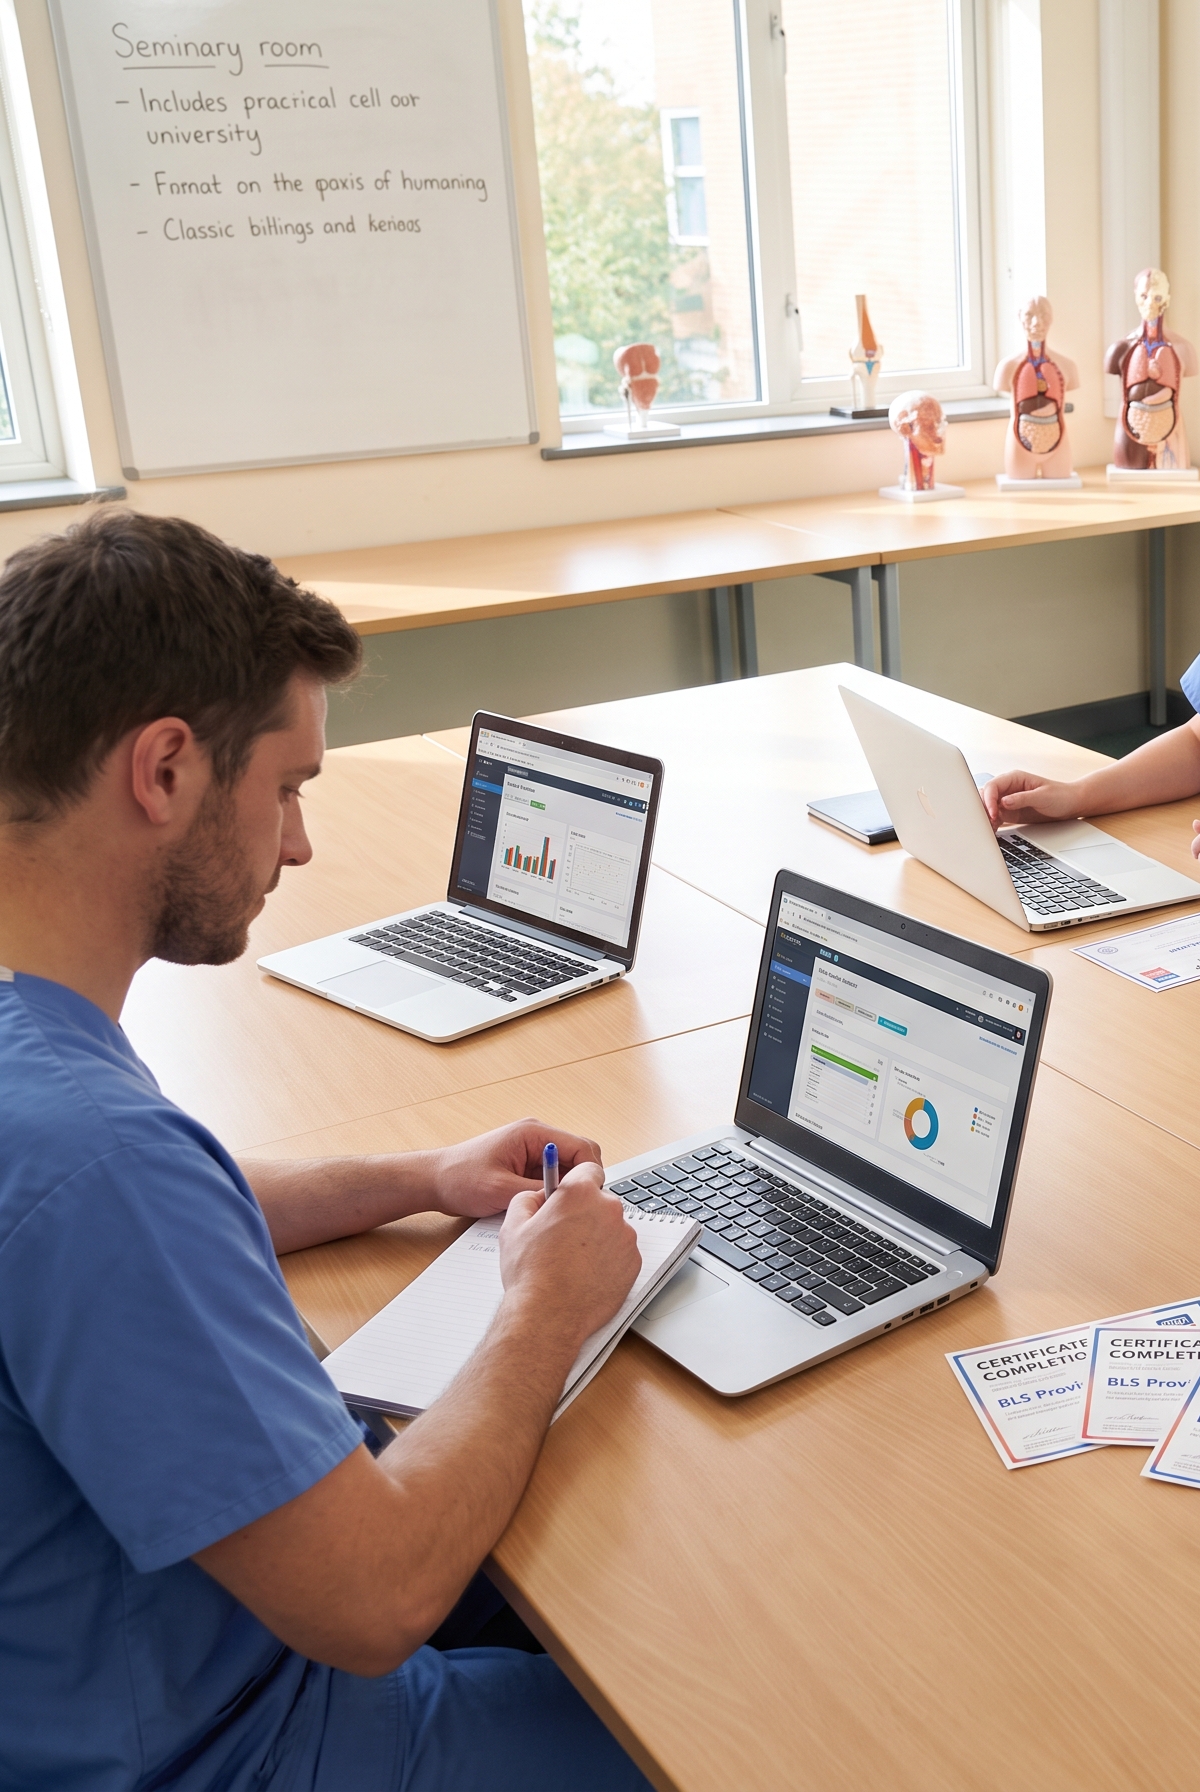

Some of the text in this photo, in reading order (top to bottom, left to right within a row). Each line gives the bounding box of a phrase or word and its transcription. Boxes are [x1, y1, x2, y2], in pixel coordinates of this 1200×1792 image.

[112, 22, 322, 76] Seminary room
[139, 88, 228, 114] Includes
[349, 87, 381, 108] cell
[146, 124, 263, 156] university
[237, 180, 262, 195] on
[273, 172, 303, 192] the
[374, 169, 392, 191] of
[400, 169, 488, 203] humaning
[163, 216, 235, 242] Classic
[323, 215, 356, 234] and
[976, 1338, 1088, 1371] CERTIFICATE
[997, 1392, 1032, 1409] BLS
[1035, 1381, 1084, 1400] Provi
[1107, 1377, 1140, 1387] BLS
